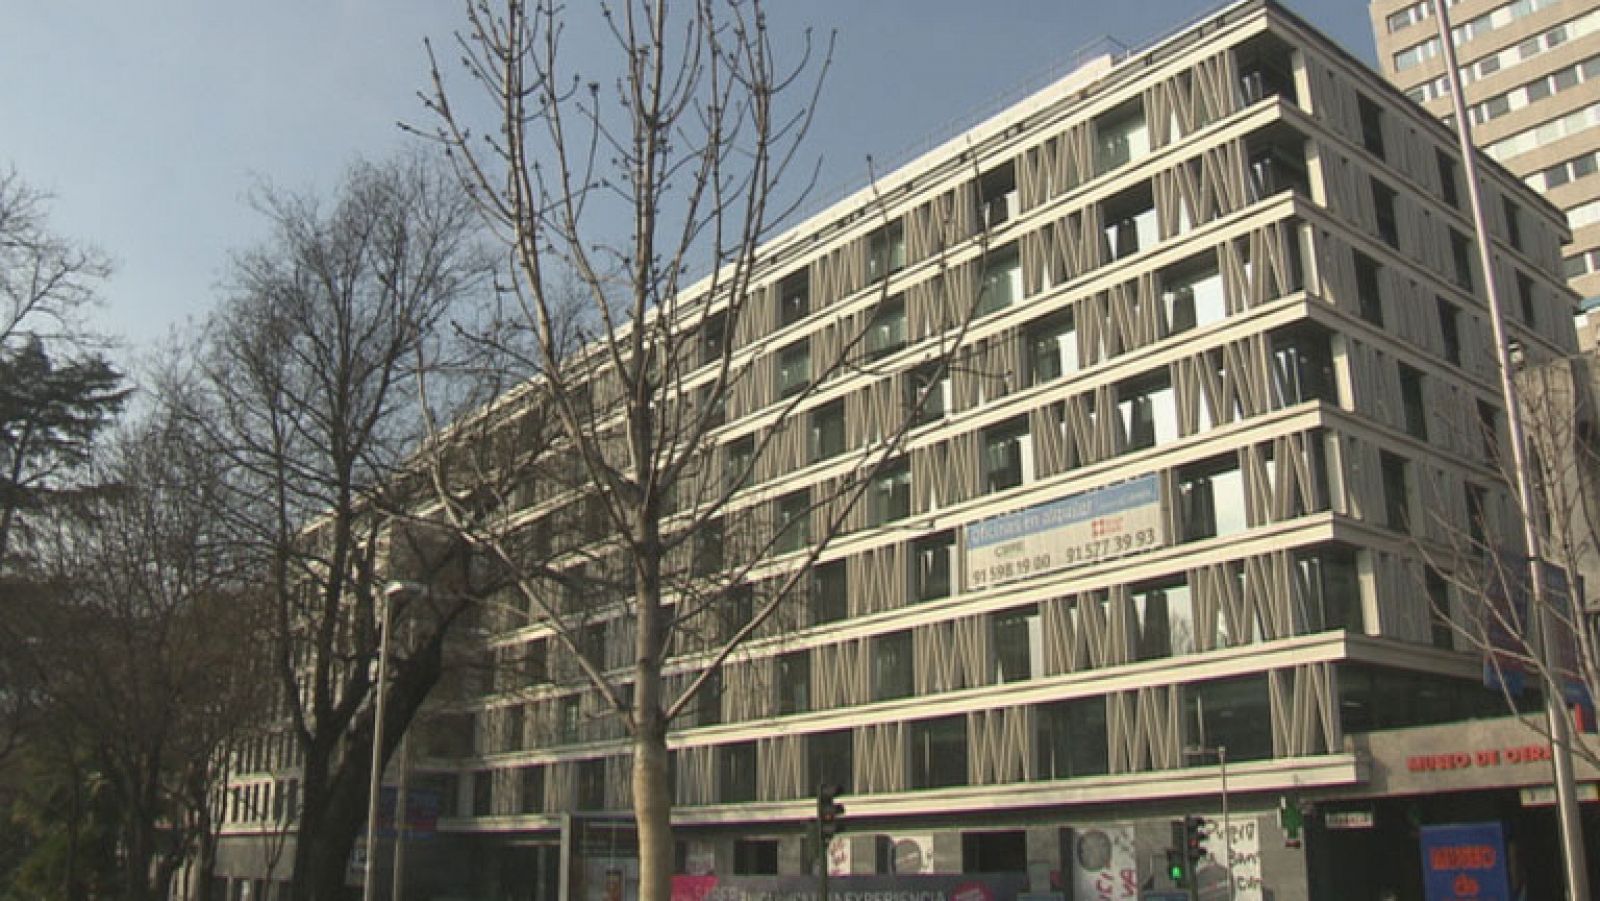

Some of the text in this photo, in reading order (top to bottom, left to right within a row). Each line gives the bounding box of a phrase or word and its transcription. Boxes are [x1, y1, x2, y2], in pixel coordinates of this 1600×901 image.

[1066, 546, 1082, 564] 91
[1115, 533, 1132, 551] 39
[1135, 527, 1155, 545] 93
[972, 569, 987, 585] 91
[1406, 752, 1471, 772] MUSEO
[1475, 749, 1500, 767] DE
[1429, 845, 1496, 870] MUSEO
